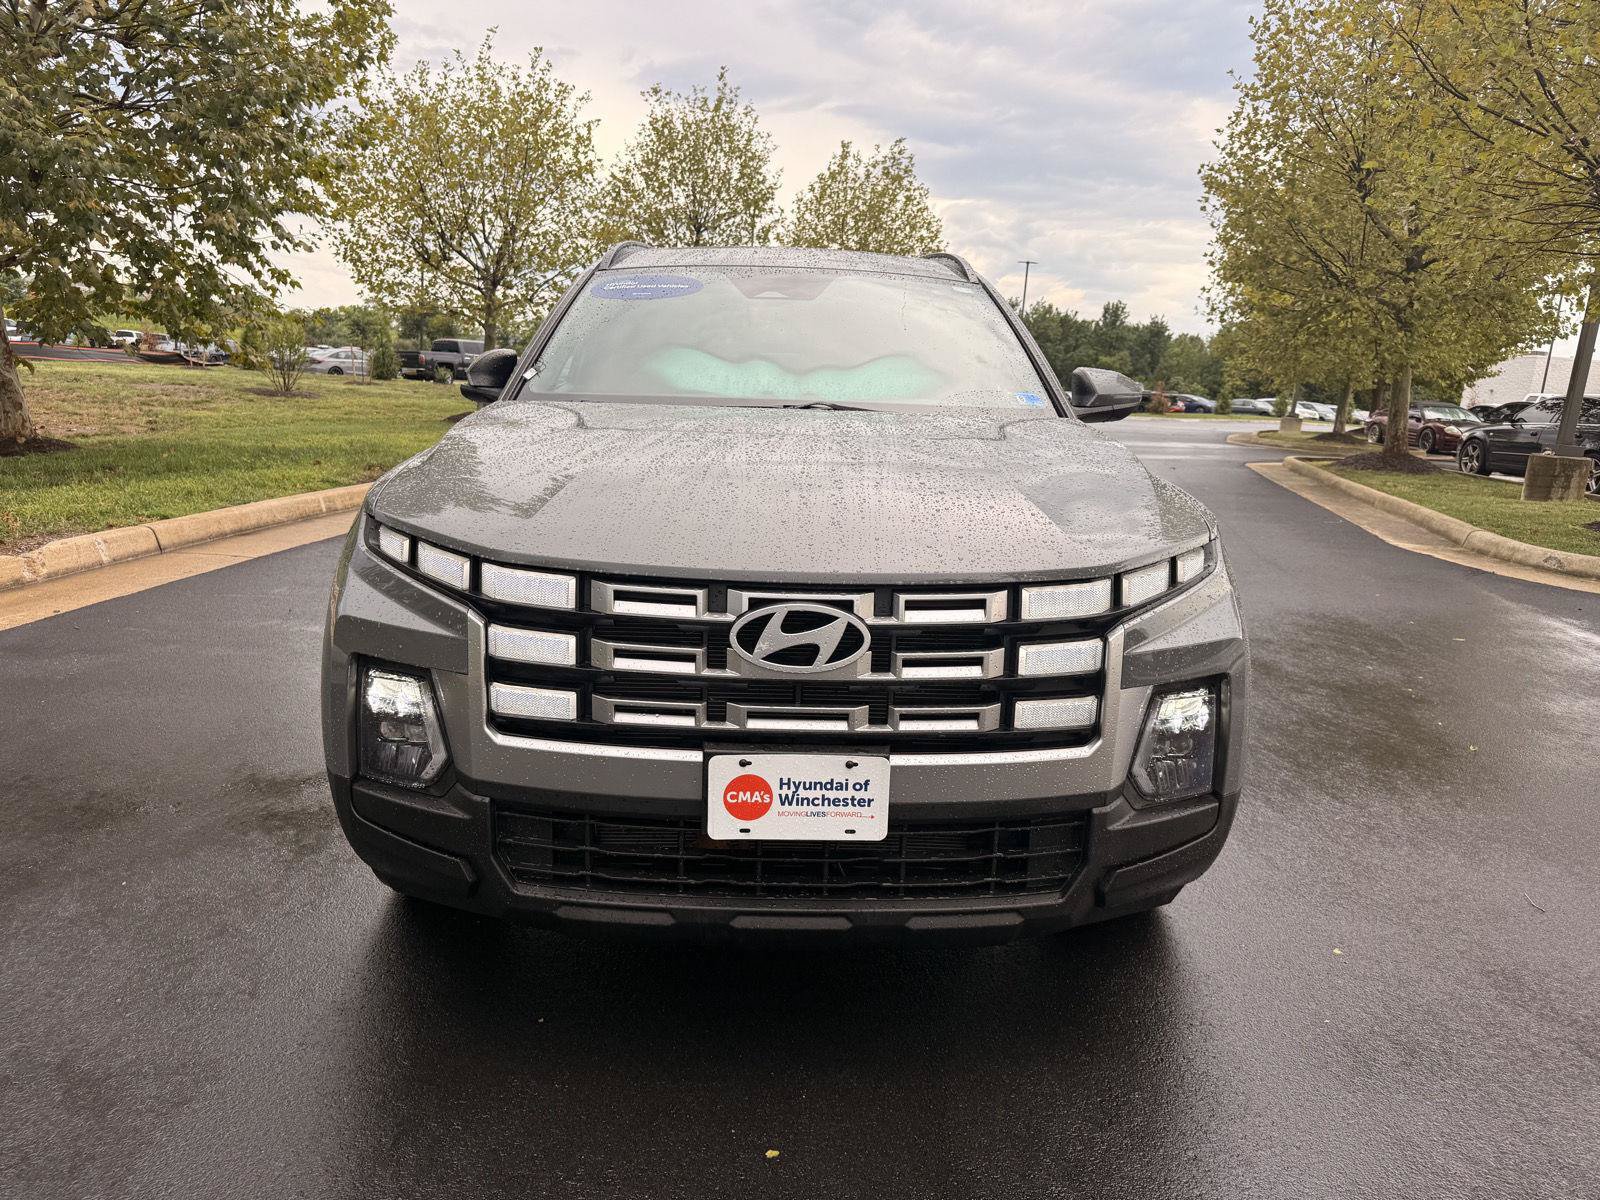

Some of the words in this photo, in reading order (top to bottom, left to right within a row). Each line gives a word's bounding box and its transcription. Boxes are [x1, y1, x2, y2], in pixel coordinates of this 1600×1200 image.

[779, 777, 849, 793] Hyundai
[852, 779, 871, 792] of
[778, 793, 875, 808] Winchester
